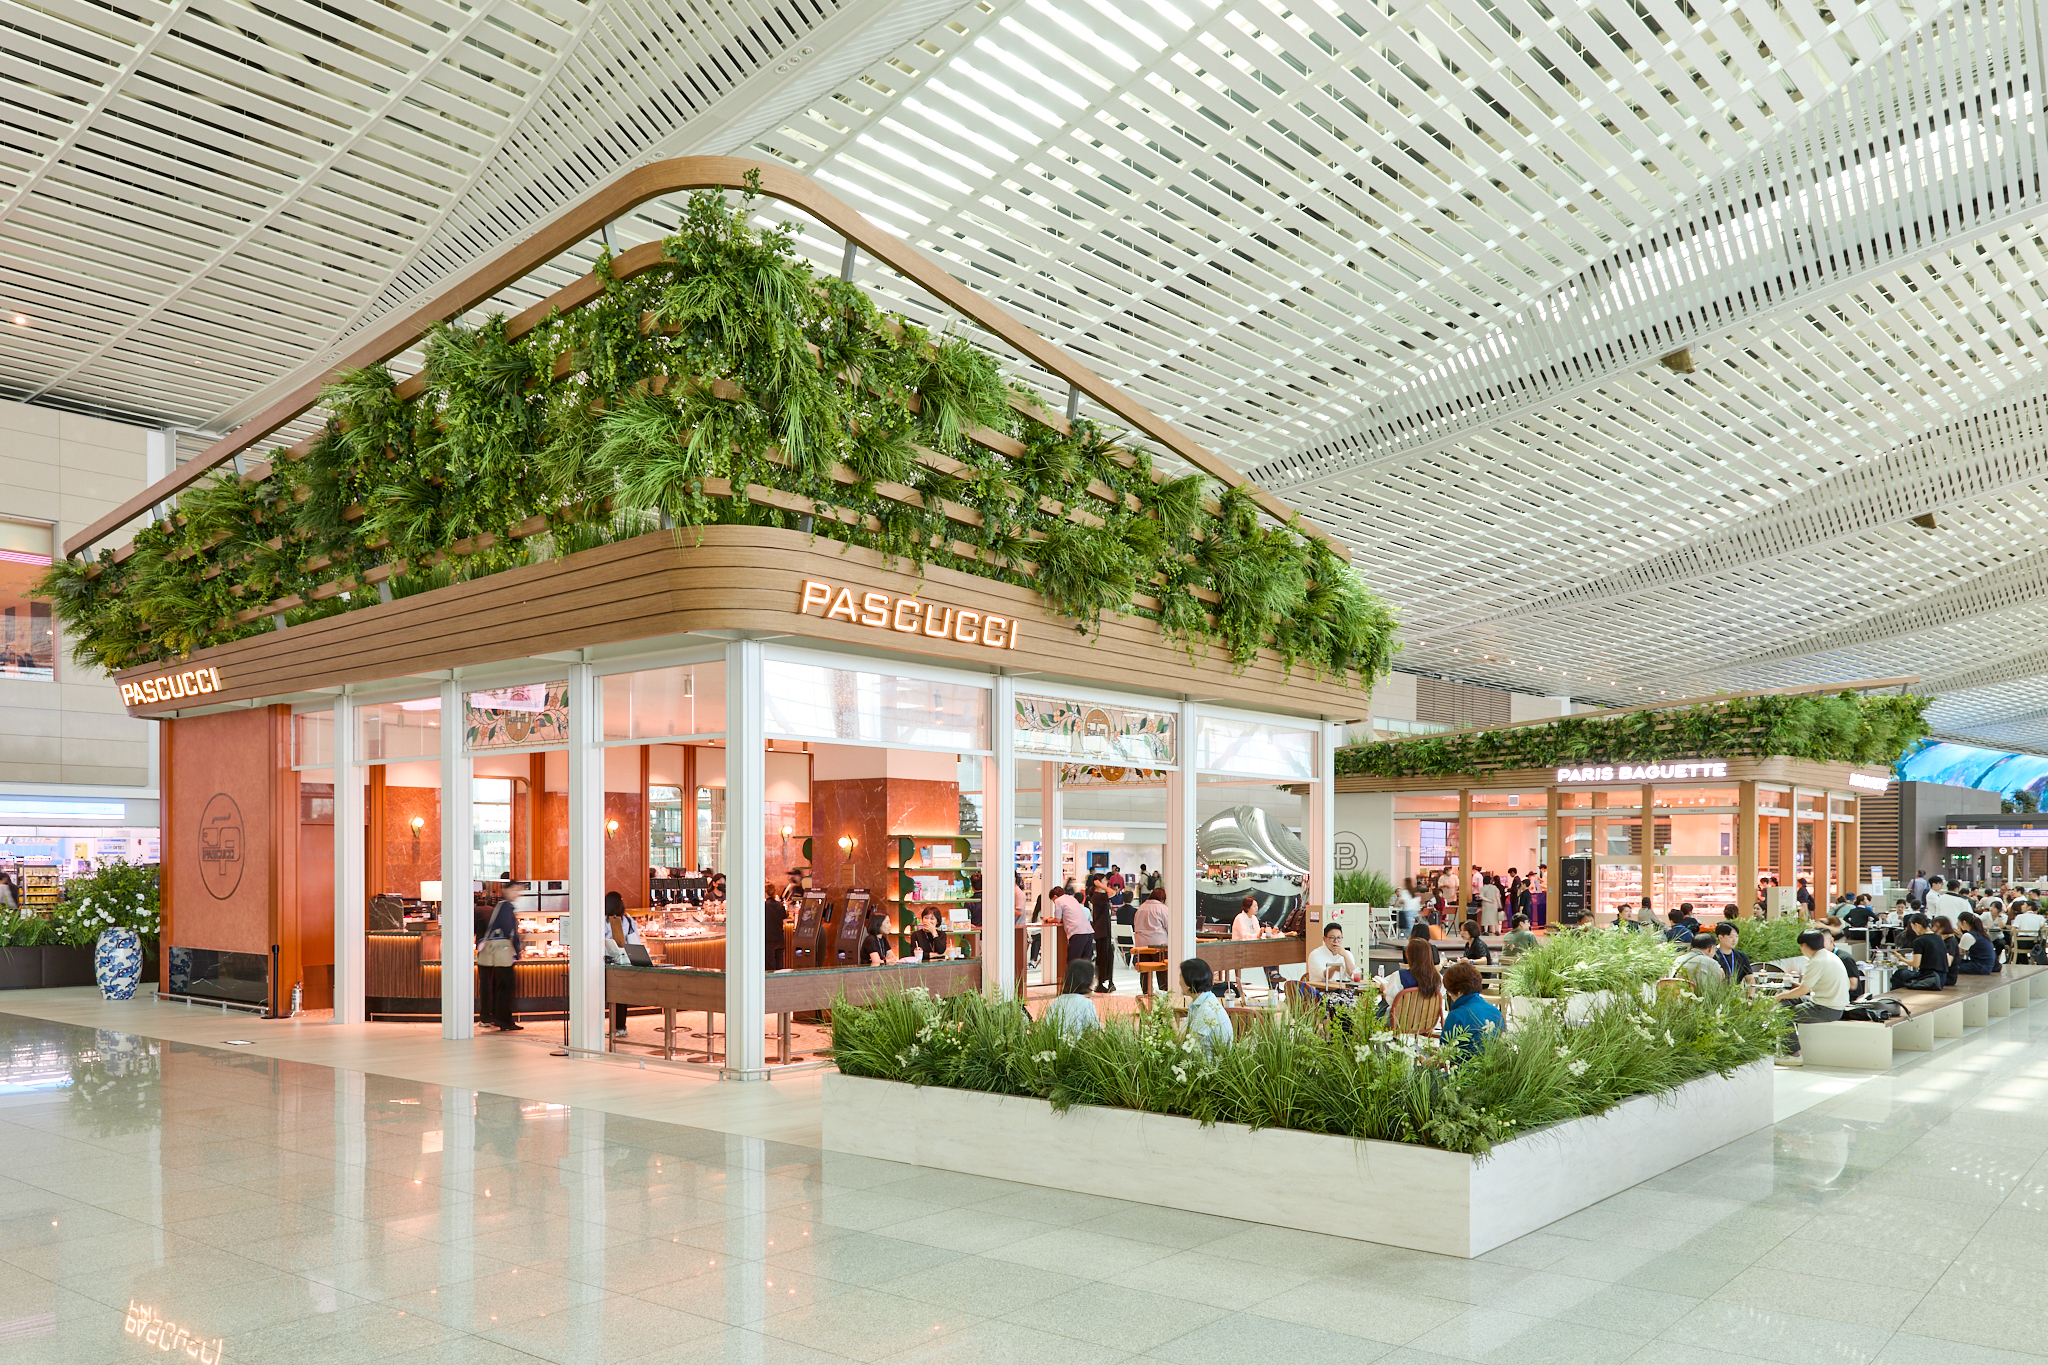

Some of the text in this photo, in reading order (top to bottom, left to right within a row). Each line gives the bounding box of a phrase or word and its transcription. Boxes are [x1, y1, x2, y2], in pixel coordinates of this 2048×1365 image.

[800, 579, 1019, 651] PASCUCCI
[120, 666, 221, 707] PASCUCCI
[1556, 763, 1727, 783] PARIS BAGUETTE
[1069, 828, 1090, 840] MATE
[203, 848, 235, 860] PASCUCCI
